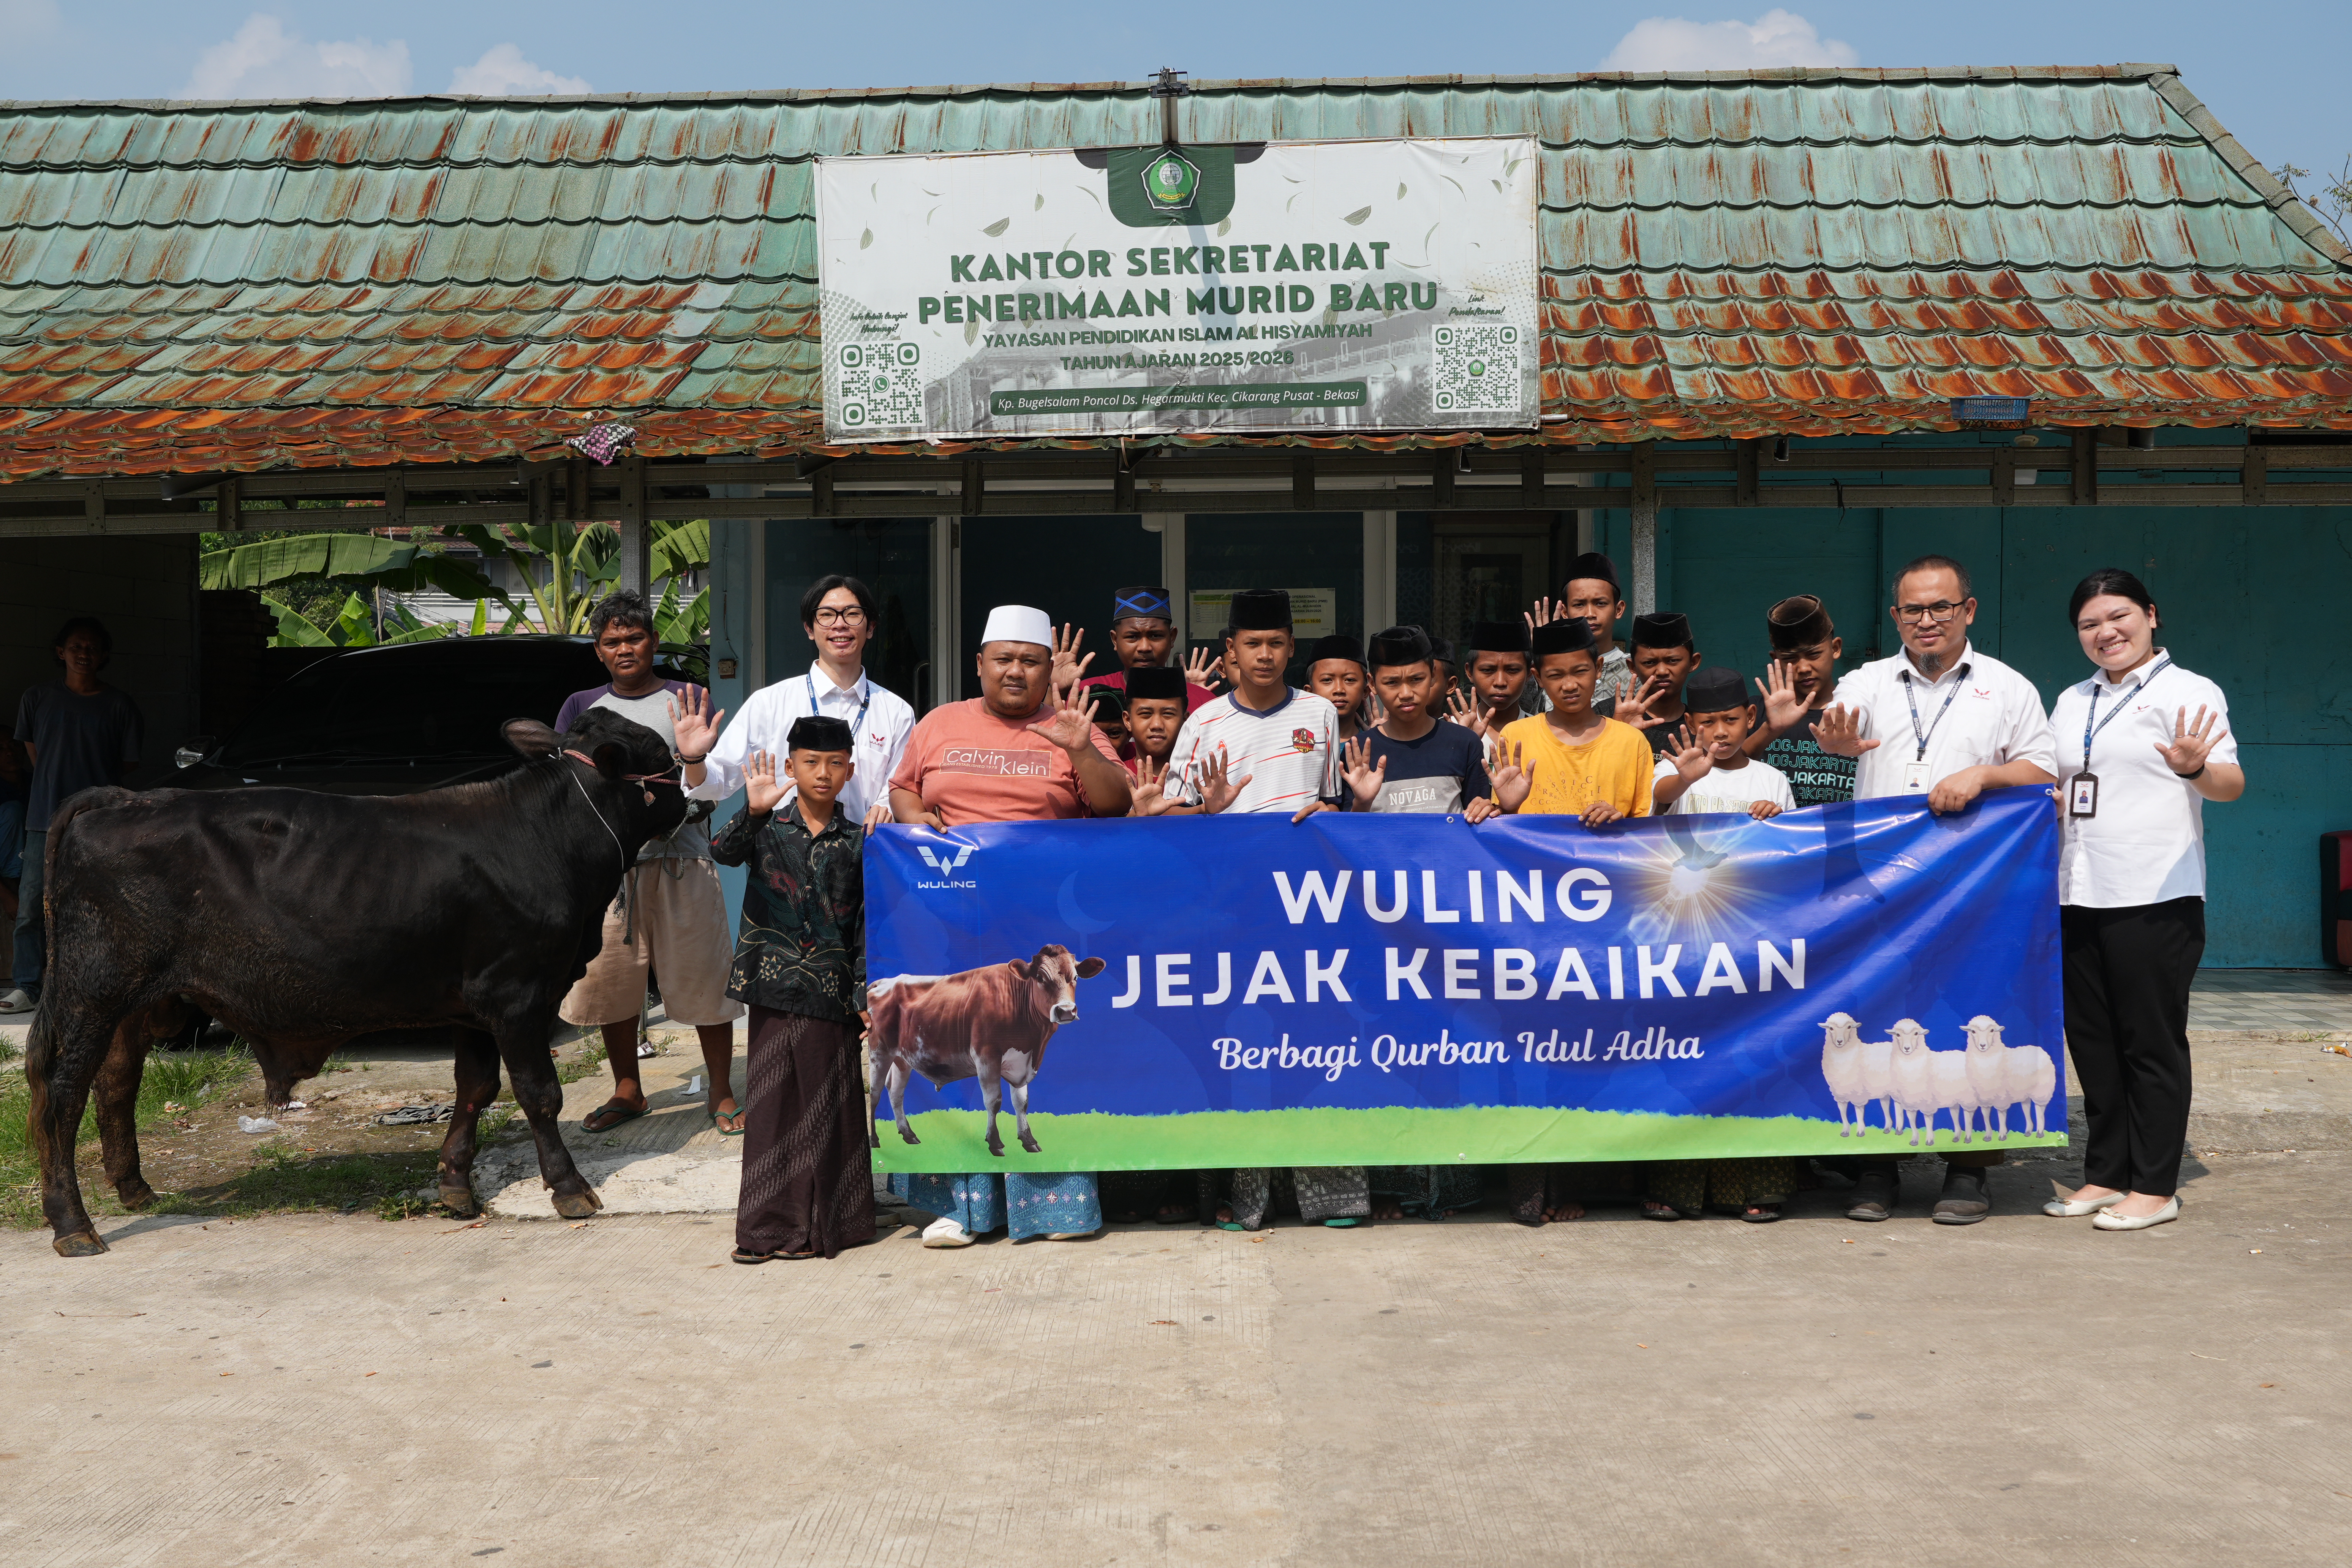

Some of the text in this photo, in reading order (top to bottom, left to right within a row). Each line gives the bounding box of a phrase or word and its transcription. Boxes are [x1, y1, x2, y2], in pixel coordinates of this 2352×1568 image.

[951, 242, 1389, 282] KANTOR SEKRETARIAT
[919, 281, 1437, 324] PENERIMAAN MURID BARU
[1468, 294, 1485, 303] Link
[850, 313, 863, 321] Info
[1448, 306, 1506, 317] Pendaftaran!
[861, 323, 899, 336] Hubungi!
[983, 324, 1372, 348] YAYASAN PENDIDIKAN ISLAM AL HISYAMIYAH
[1061, 350, 1294, 370] TAHUN AJARAN 2025/2026
[998, 399, 1014, 411] Kp.
[1018, 396, 1080, 410] Bugelsalam
[1083, 395, 1119, 406] Poncol
[1122, 395, 1138, 405] Ds.
[1142, 392, 1204, 406] Hegarmukti
[1207, 392, 1228, 403] Kec.
[1232, 392, 1280, 404] Cikarang
[1283, 390, 1314, 401] Pusat
[1324, 389, 1359, 400] Bekasi
[1949, 680, 1962, 699] SGMW
[851, 718, 861, 735] INDONESIA
[1913, 717, 1922, 738] SGMW
[947, 750, 1046, 775] Calvin Klein
[1389, 788, 1437, 806] NOVAGA
[1272, 868, 1612, 924] WULING
[1112, 938, 1805, 1008] JEJAK KEBAIKAN
[1212, 1026, 1705, 1082] Berbagi Qurban Idul Adha
